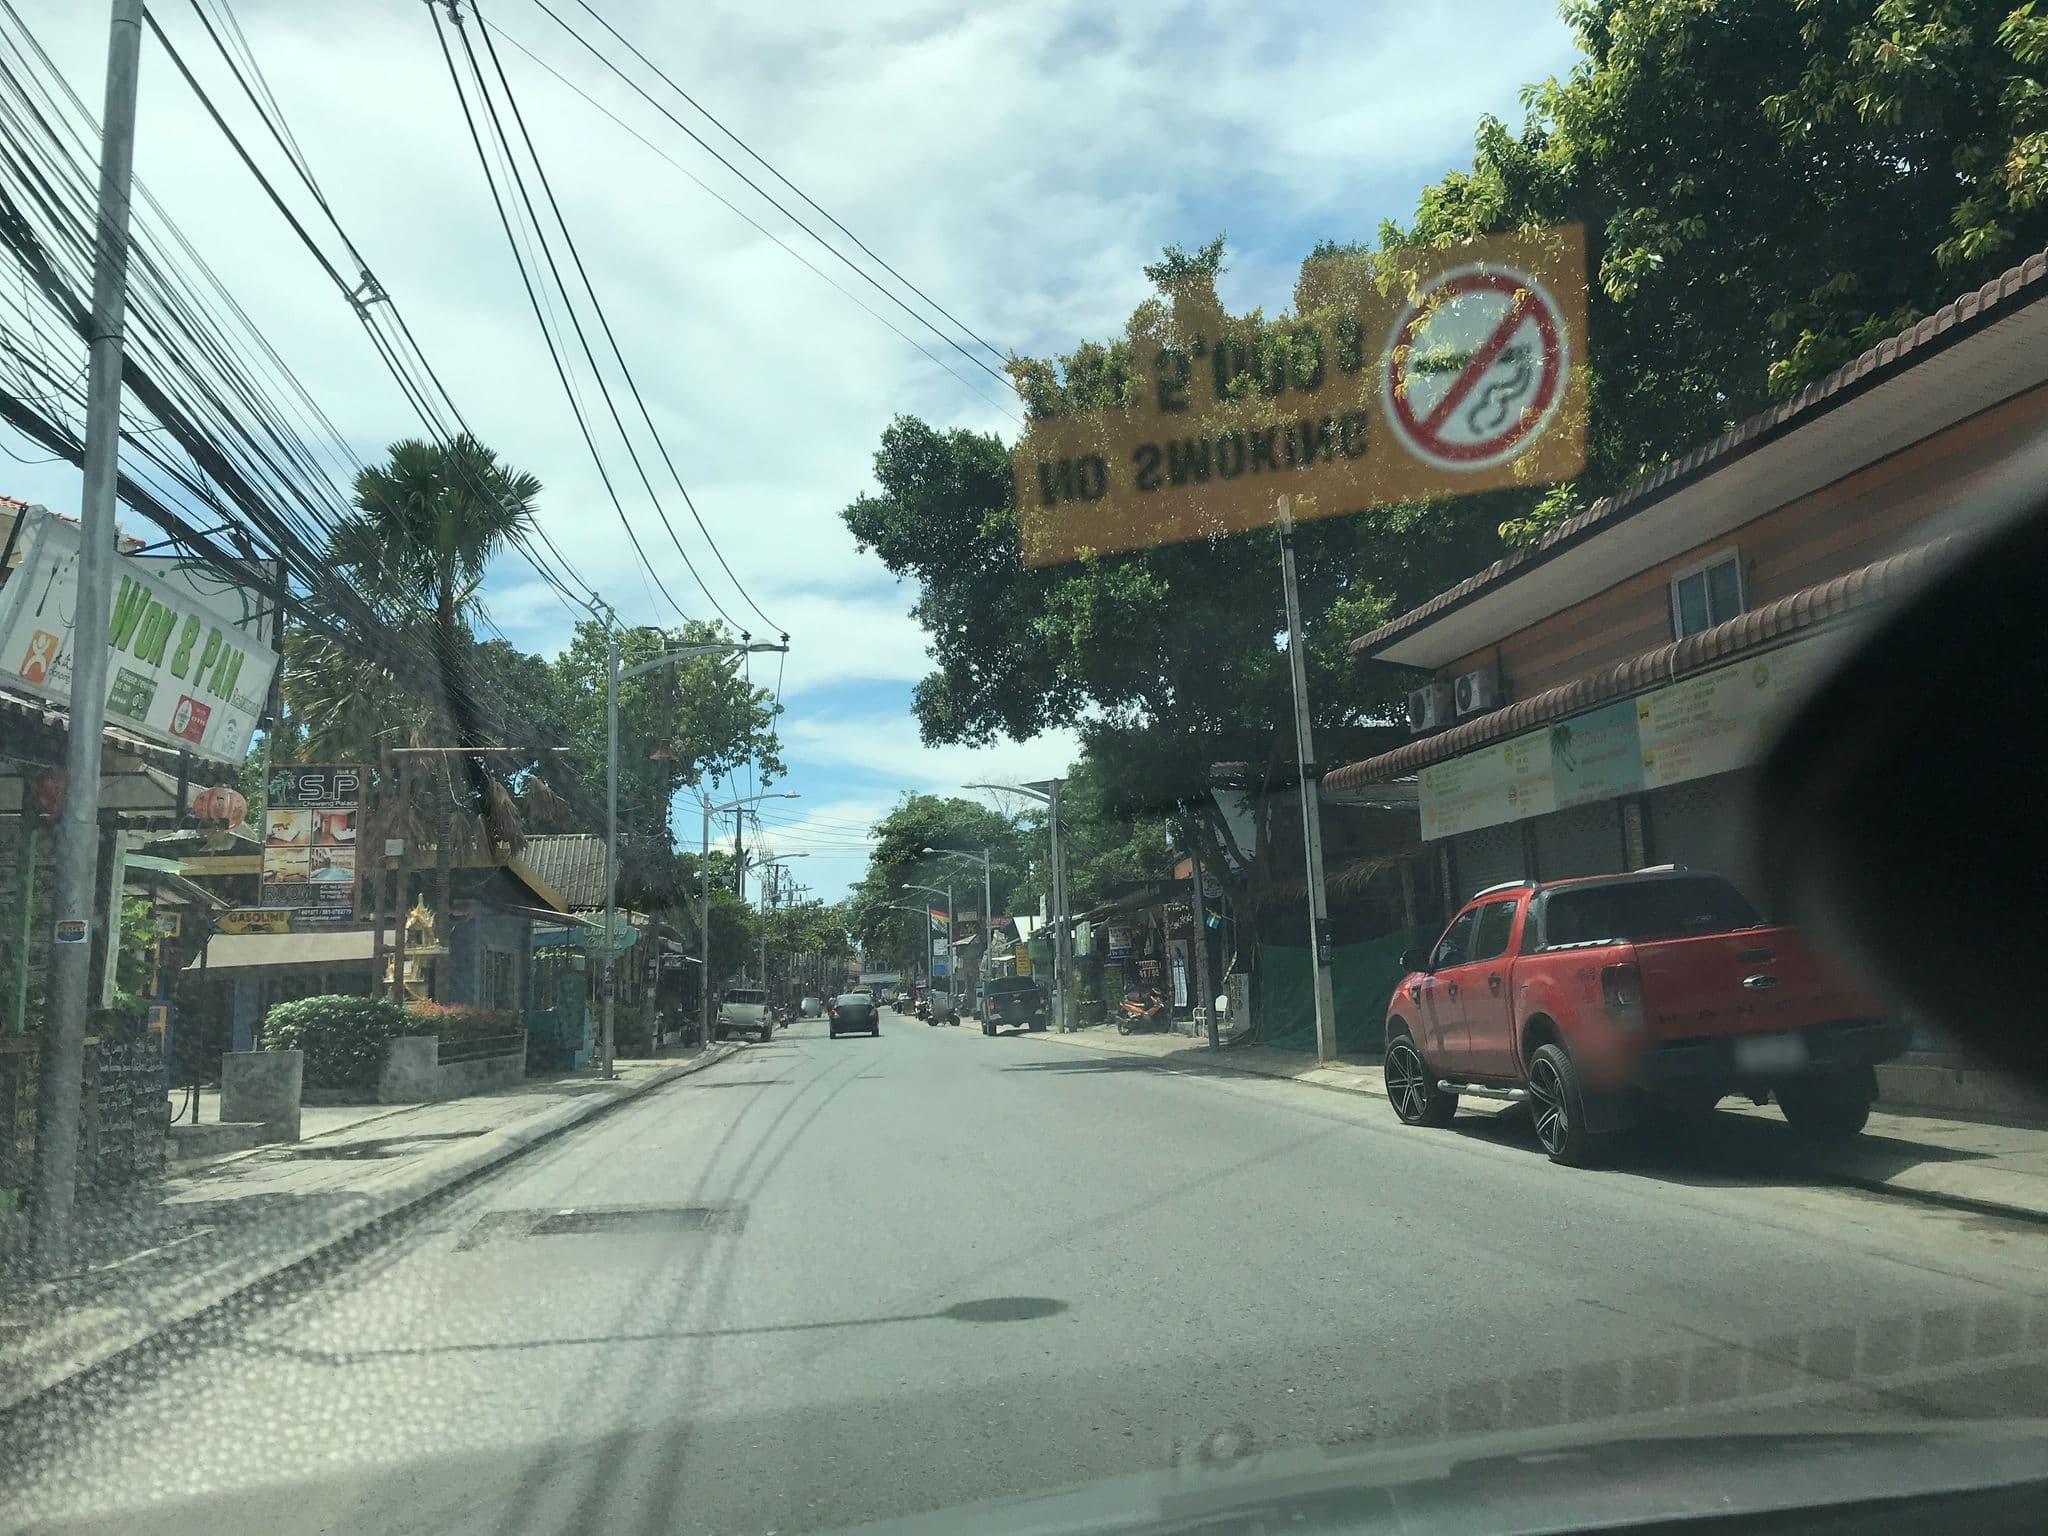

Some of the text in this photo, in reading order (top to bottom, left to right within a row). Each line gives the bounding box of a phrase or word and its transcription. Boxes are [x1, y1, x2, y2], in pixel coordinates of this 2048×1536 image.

[108, 574, 178, 668] WOK
[193, 627, 245, 703] PAN
[229, 911, 285, 923] GASOLINE
